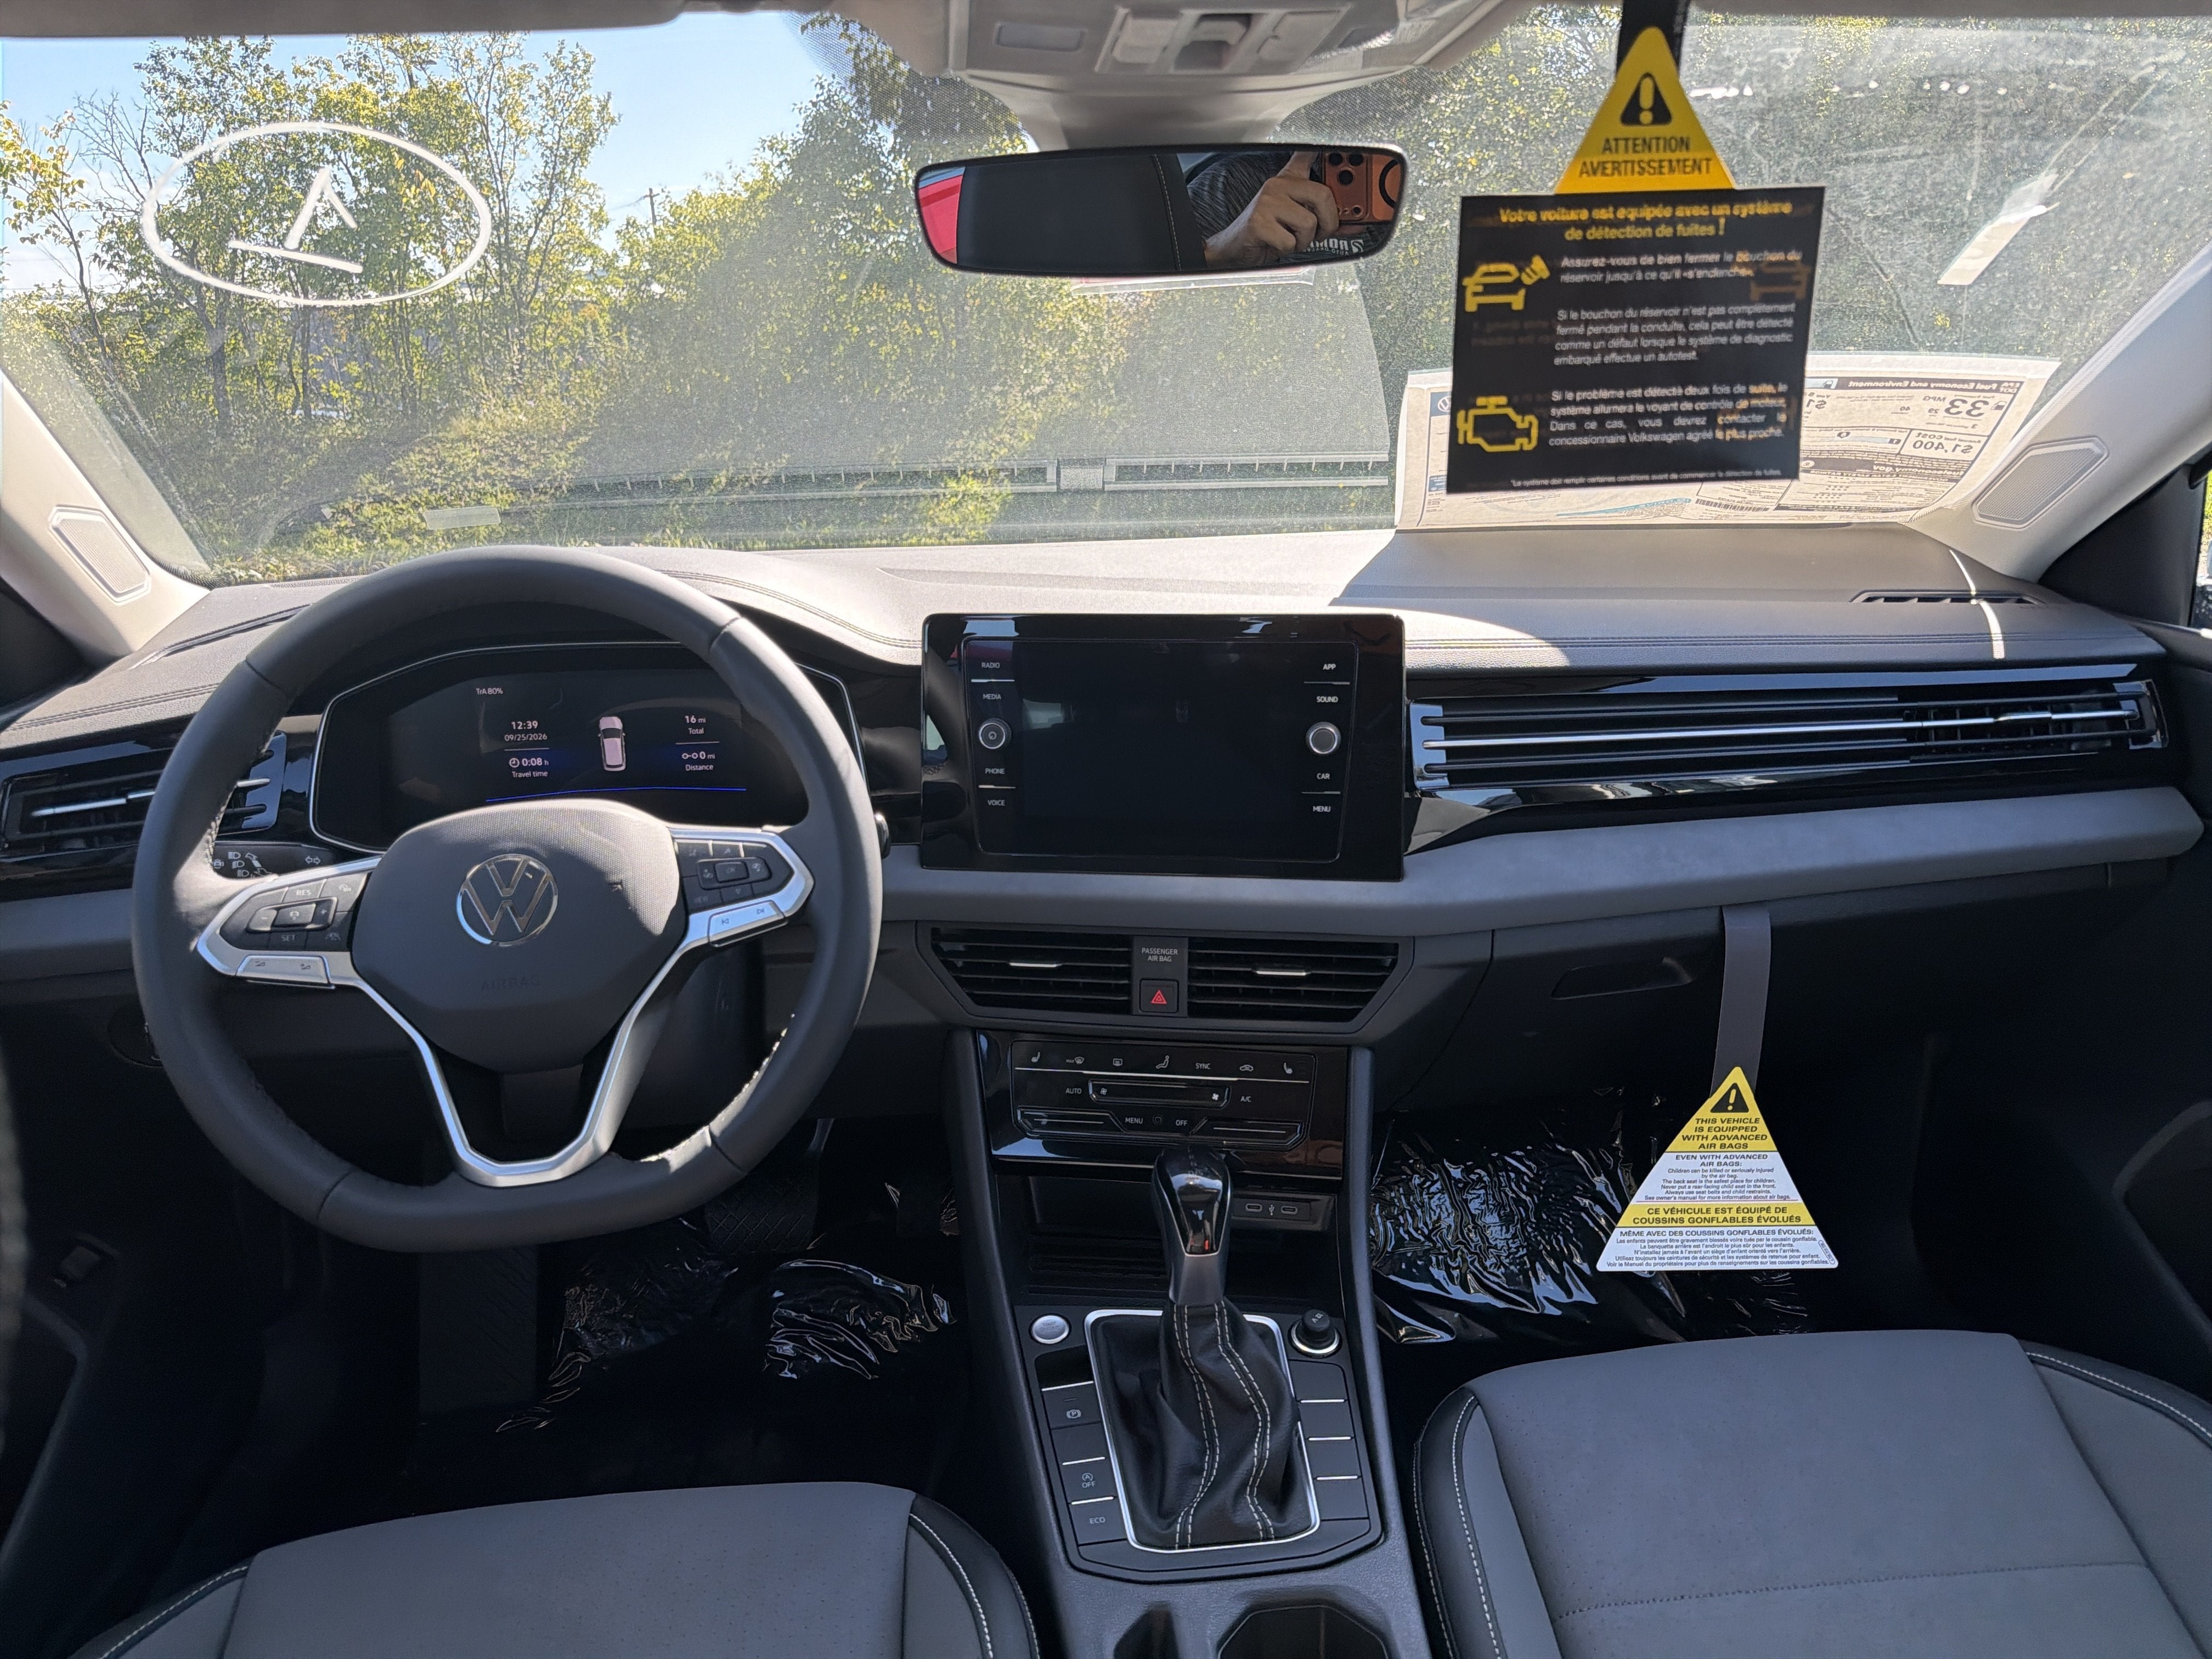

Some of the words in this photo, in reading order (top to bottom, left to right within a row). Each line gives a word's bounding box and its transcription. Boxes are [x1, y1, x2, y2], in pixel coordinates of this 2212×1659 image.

[1601, 137, 1690, 154] ATTENTION
[1578, 157, 1712, 178] AVERTISSEMENT
[1499, 206, 1537, 223] Votre
[1539, 207, 1589, 221] voiture
[1592, 205, 1614, 219] est
[1675, 205, 1710, 217] avec
[1712, 204, 1730, 216] un
[1733, 200, 1793, 218] système
[1565, 227, 1584, 240] de
[1586, 225, 1653, 240] détection
[1655, 223, 1673, 238] de
[1677, 223, 1716, 237] fuites
[1718, 217, 1725, 235] !
[1557, 309, 1567, 321] Si
[1570, 309, 1578, 320] le
[1581, 308, 1624, 320] bouchon
[1625, 307, 1638, 318] du
[1639, 306, 1681, 318] réservoir
[1683, 305, 1707, 317] n'est
[1708, 306, 1726, 318] pas
[1728, 302, 1796, 315] complètement
[1550, 421, 1577, 431] Dans
[1584, 421, 1599, 430] ce
[1605, 419, 1627, 429] cas,
[1638, 417, 1663, 427] vous
[1673, 415, 1708, 426] devrez
[1717, 413, 1765, 425] contacter
[1776, 411, 1787, 422] le
[511, 720, 538, 730] 12:39
[504, 733, 548, 741] 09/25/2026
[522, 758, 543, 766] 0:08
[1142, 947, 1178, 956] PASSENGER
[1663, 1206, 1711, 1215] VÉHICULE
[1736, 1205, 1771, 1214] ÉQUIPÉ
[1757, 1215, 1801, 1223] ÉVOLUÉS
